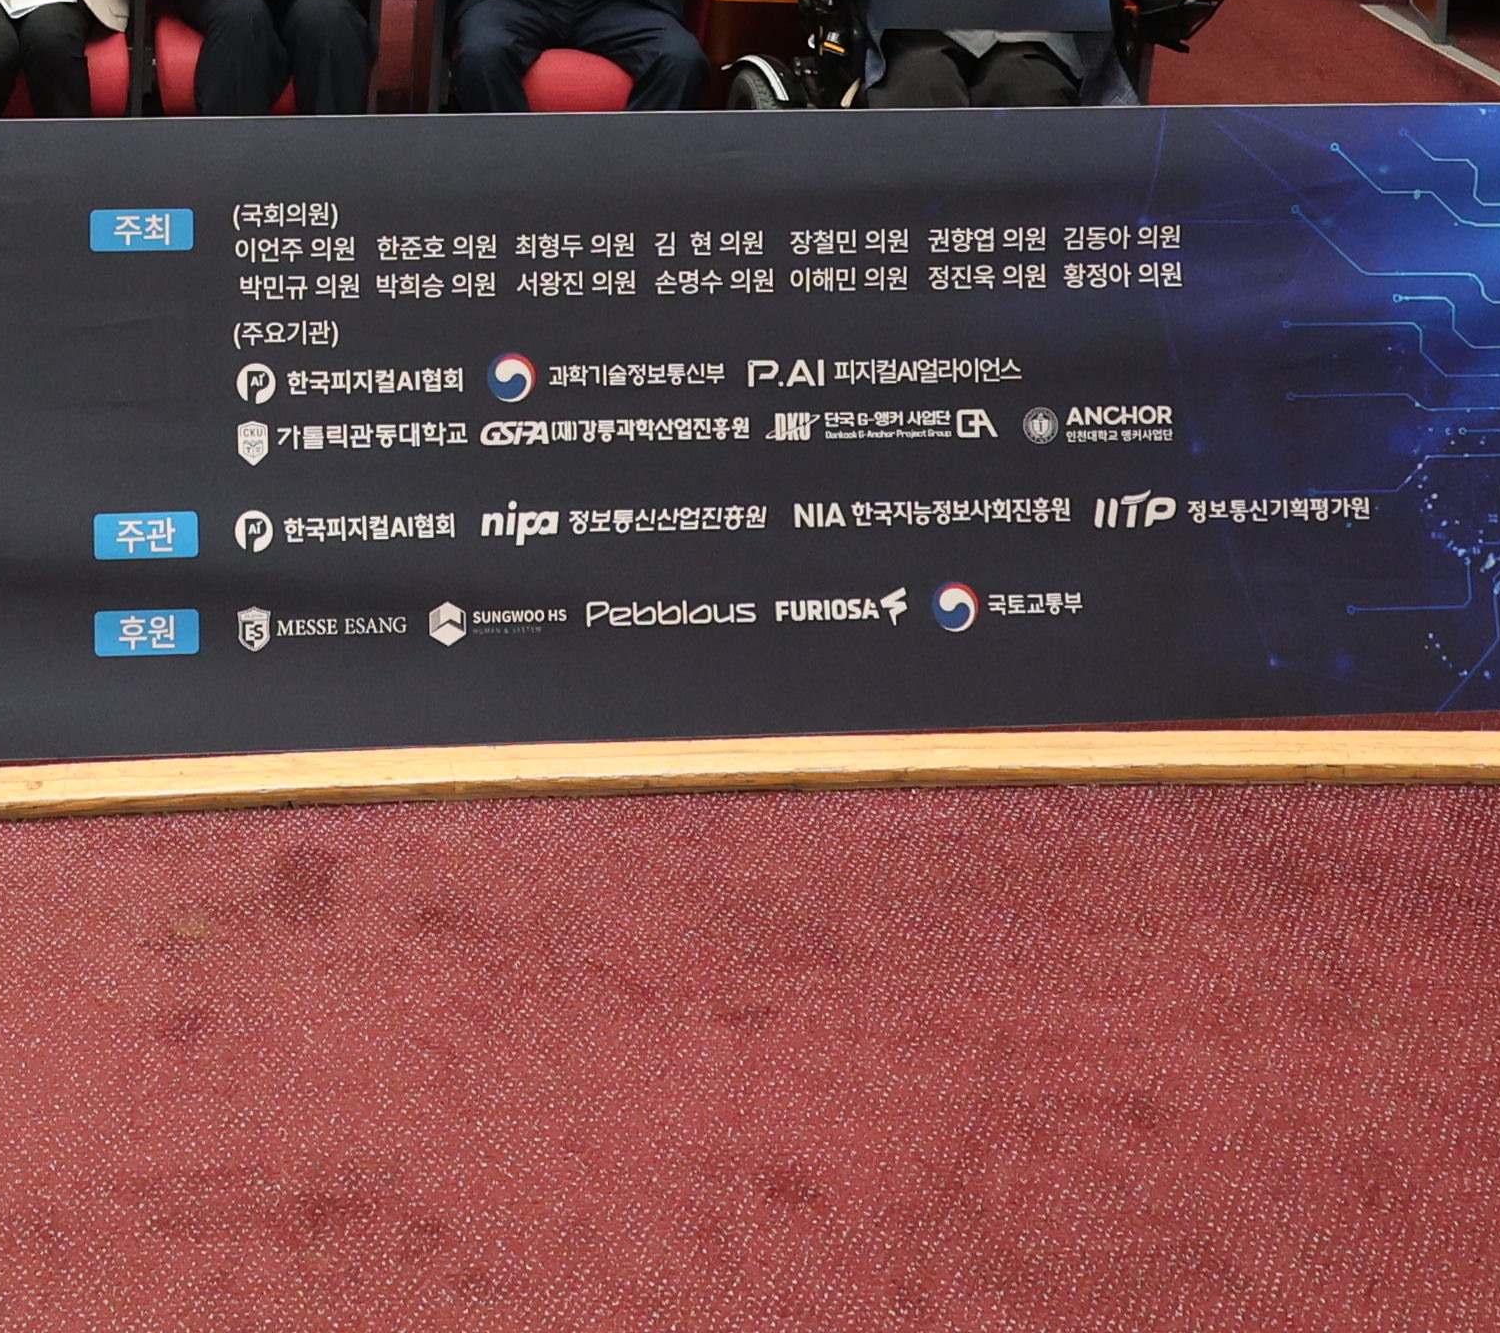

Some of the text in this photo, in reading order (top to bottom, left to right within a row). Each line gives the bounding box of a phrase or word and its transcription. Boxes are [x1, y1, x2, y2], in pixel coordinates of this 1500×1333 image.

[114, 214, 169, 245] 주최
[234, 202, 337, 230] (국회의원)
[236, 225, 1180, 262] 이언주 의원 한준호 의원 최형두 의원 김 현 의원 장철민 의원 권향엽 의원 김동아 의원
[240, 262, 1182, 300] 박민규 의원 박희승 의원 서왕진 의원 손명수 의원 이해민 의원 정진욱 의원 황정아 의원
[234, 320, 338, 349] (주요기관)
[287, 368, 462, 394] 한국피지컬AI협회
[550, 363, 724, 386] 과학기술정보통신부
[835, 358, 1021, 384] 피지컬AI얼라이언스
[825, 411, 951, 427] 단국 G-앵커 사업단
[1067, 406, 1172, 425] ANCHOR
[277, 422, 468, 449] 가톨릭관동대학교
[1066, 429, 1118, 442] 인천대학교
[482, 501, 766, 545] nipa 정보통신산업진흥원
[794, 498, 1070, 527] NIA 한국지능정보사회진흥원
[1188, 498, 1369, 523] 정보통신기획평가원
[113, 516, 178, 553] 주관
[284, 513, 454, 542] 한국피지컬AI협회
[473, 609, 567, 624] SUNGWOO HS
[587, 601, 756, 627] Pebblous
[776, 597, 879, 624] FURIOSA
[988, 593, 1082, 615] 국토교통부
[115, 615, 179, 653] 후원
[276, 617, 407, 637] MESSE ESANG
